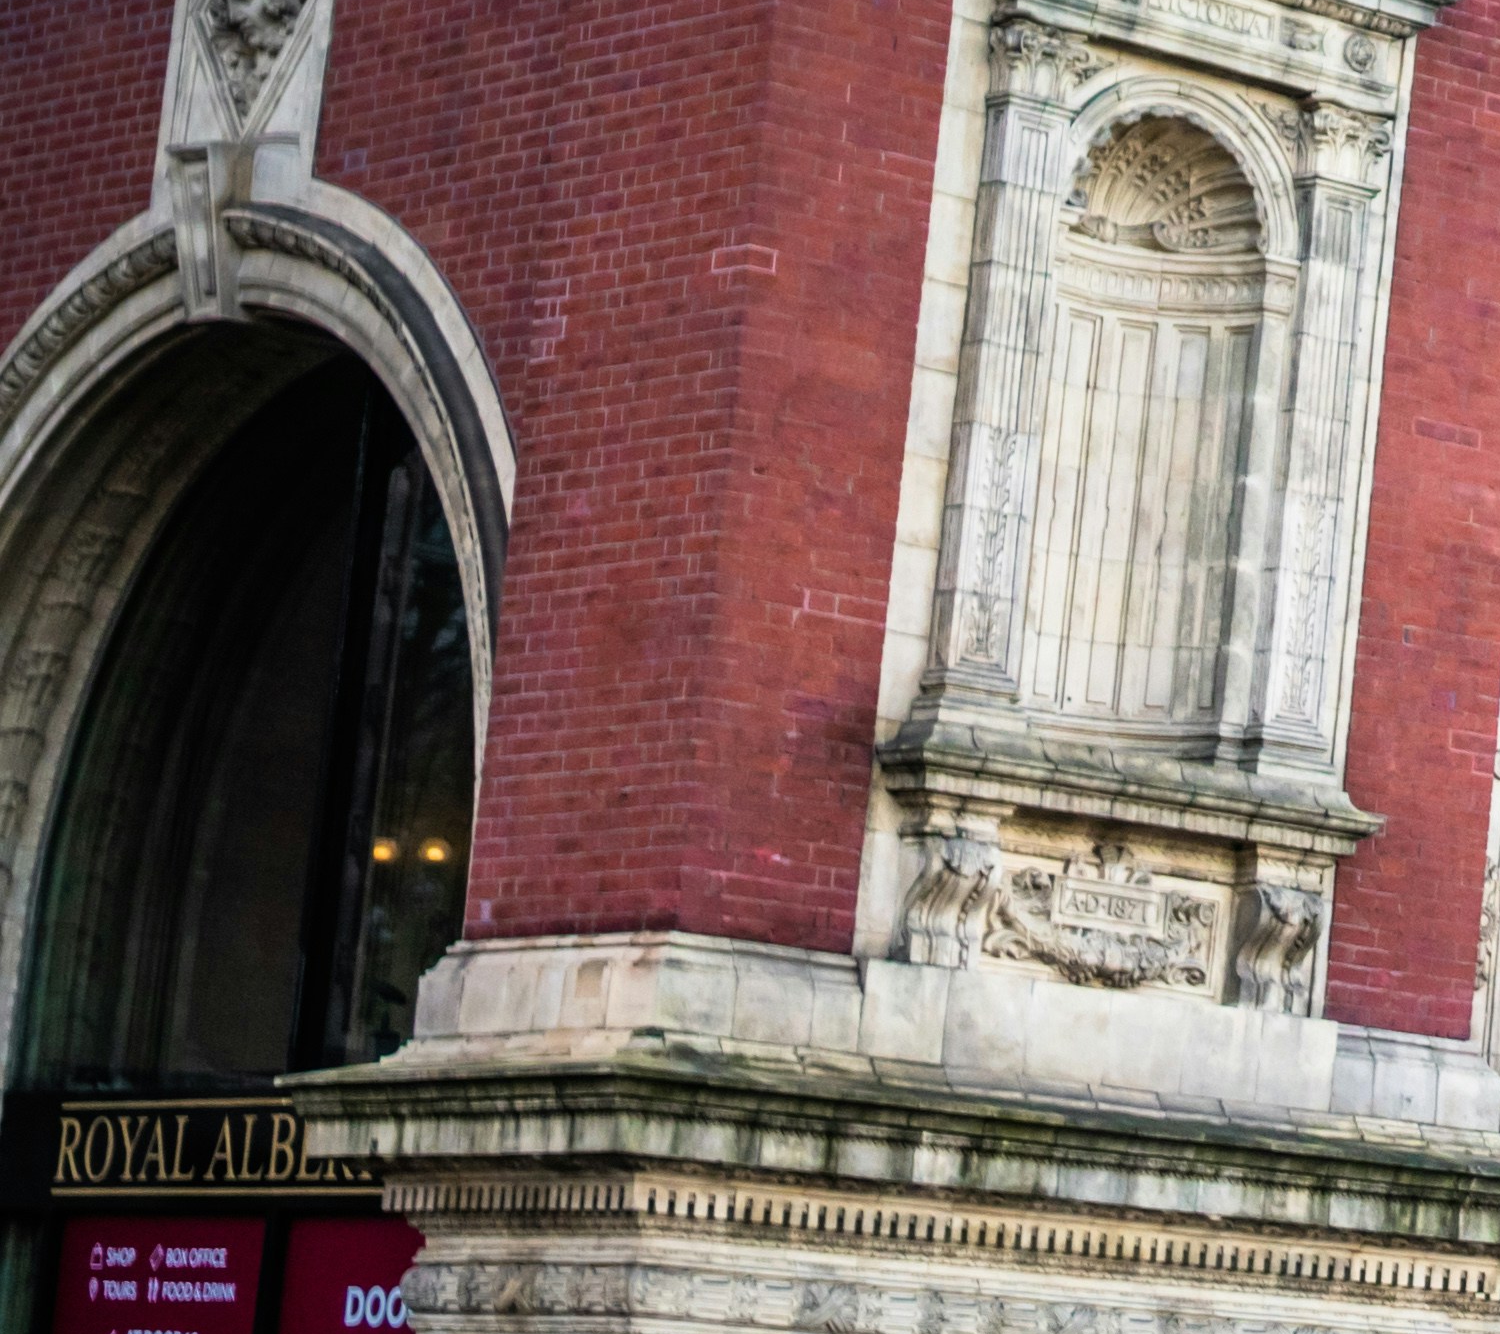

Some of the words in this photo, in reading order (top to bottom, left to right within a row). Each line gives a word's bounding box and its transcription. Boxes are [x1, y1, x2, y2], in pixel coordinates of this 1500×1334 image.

[54, 1115, 195, 1183] ROYAL
[203, 1113, 372, 1182] ALBE
[106, 1247, 137, 1267] SHOP
[166, 1248, 188, 1267] BOX
[189, 1248, 227, 1268] OFFICE
[103, 1280, 137, 1301] TOURS
[162, 1281, 193, 1301] FOOD
[194, 1282, 201, 1301] &
[202, 1282, 236, 1302] DRINK
[345, 1285, 414, 1329] DOO
